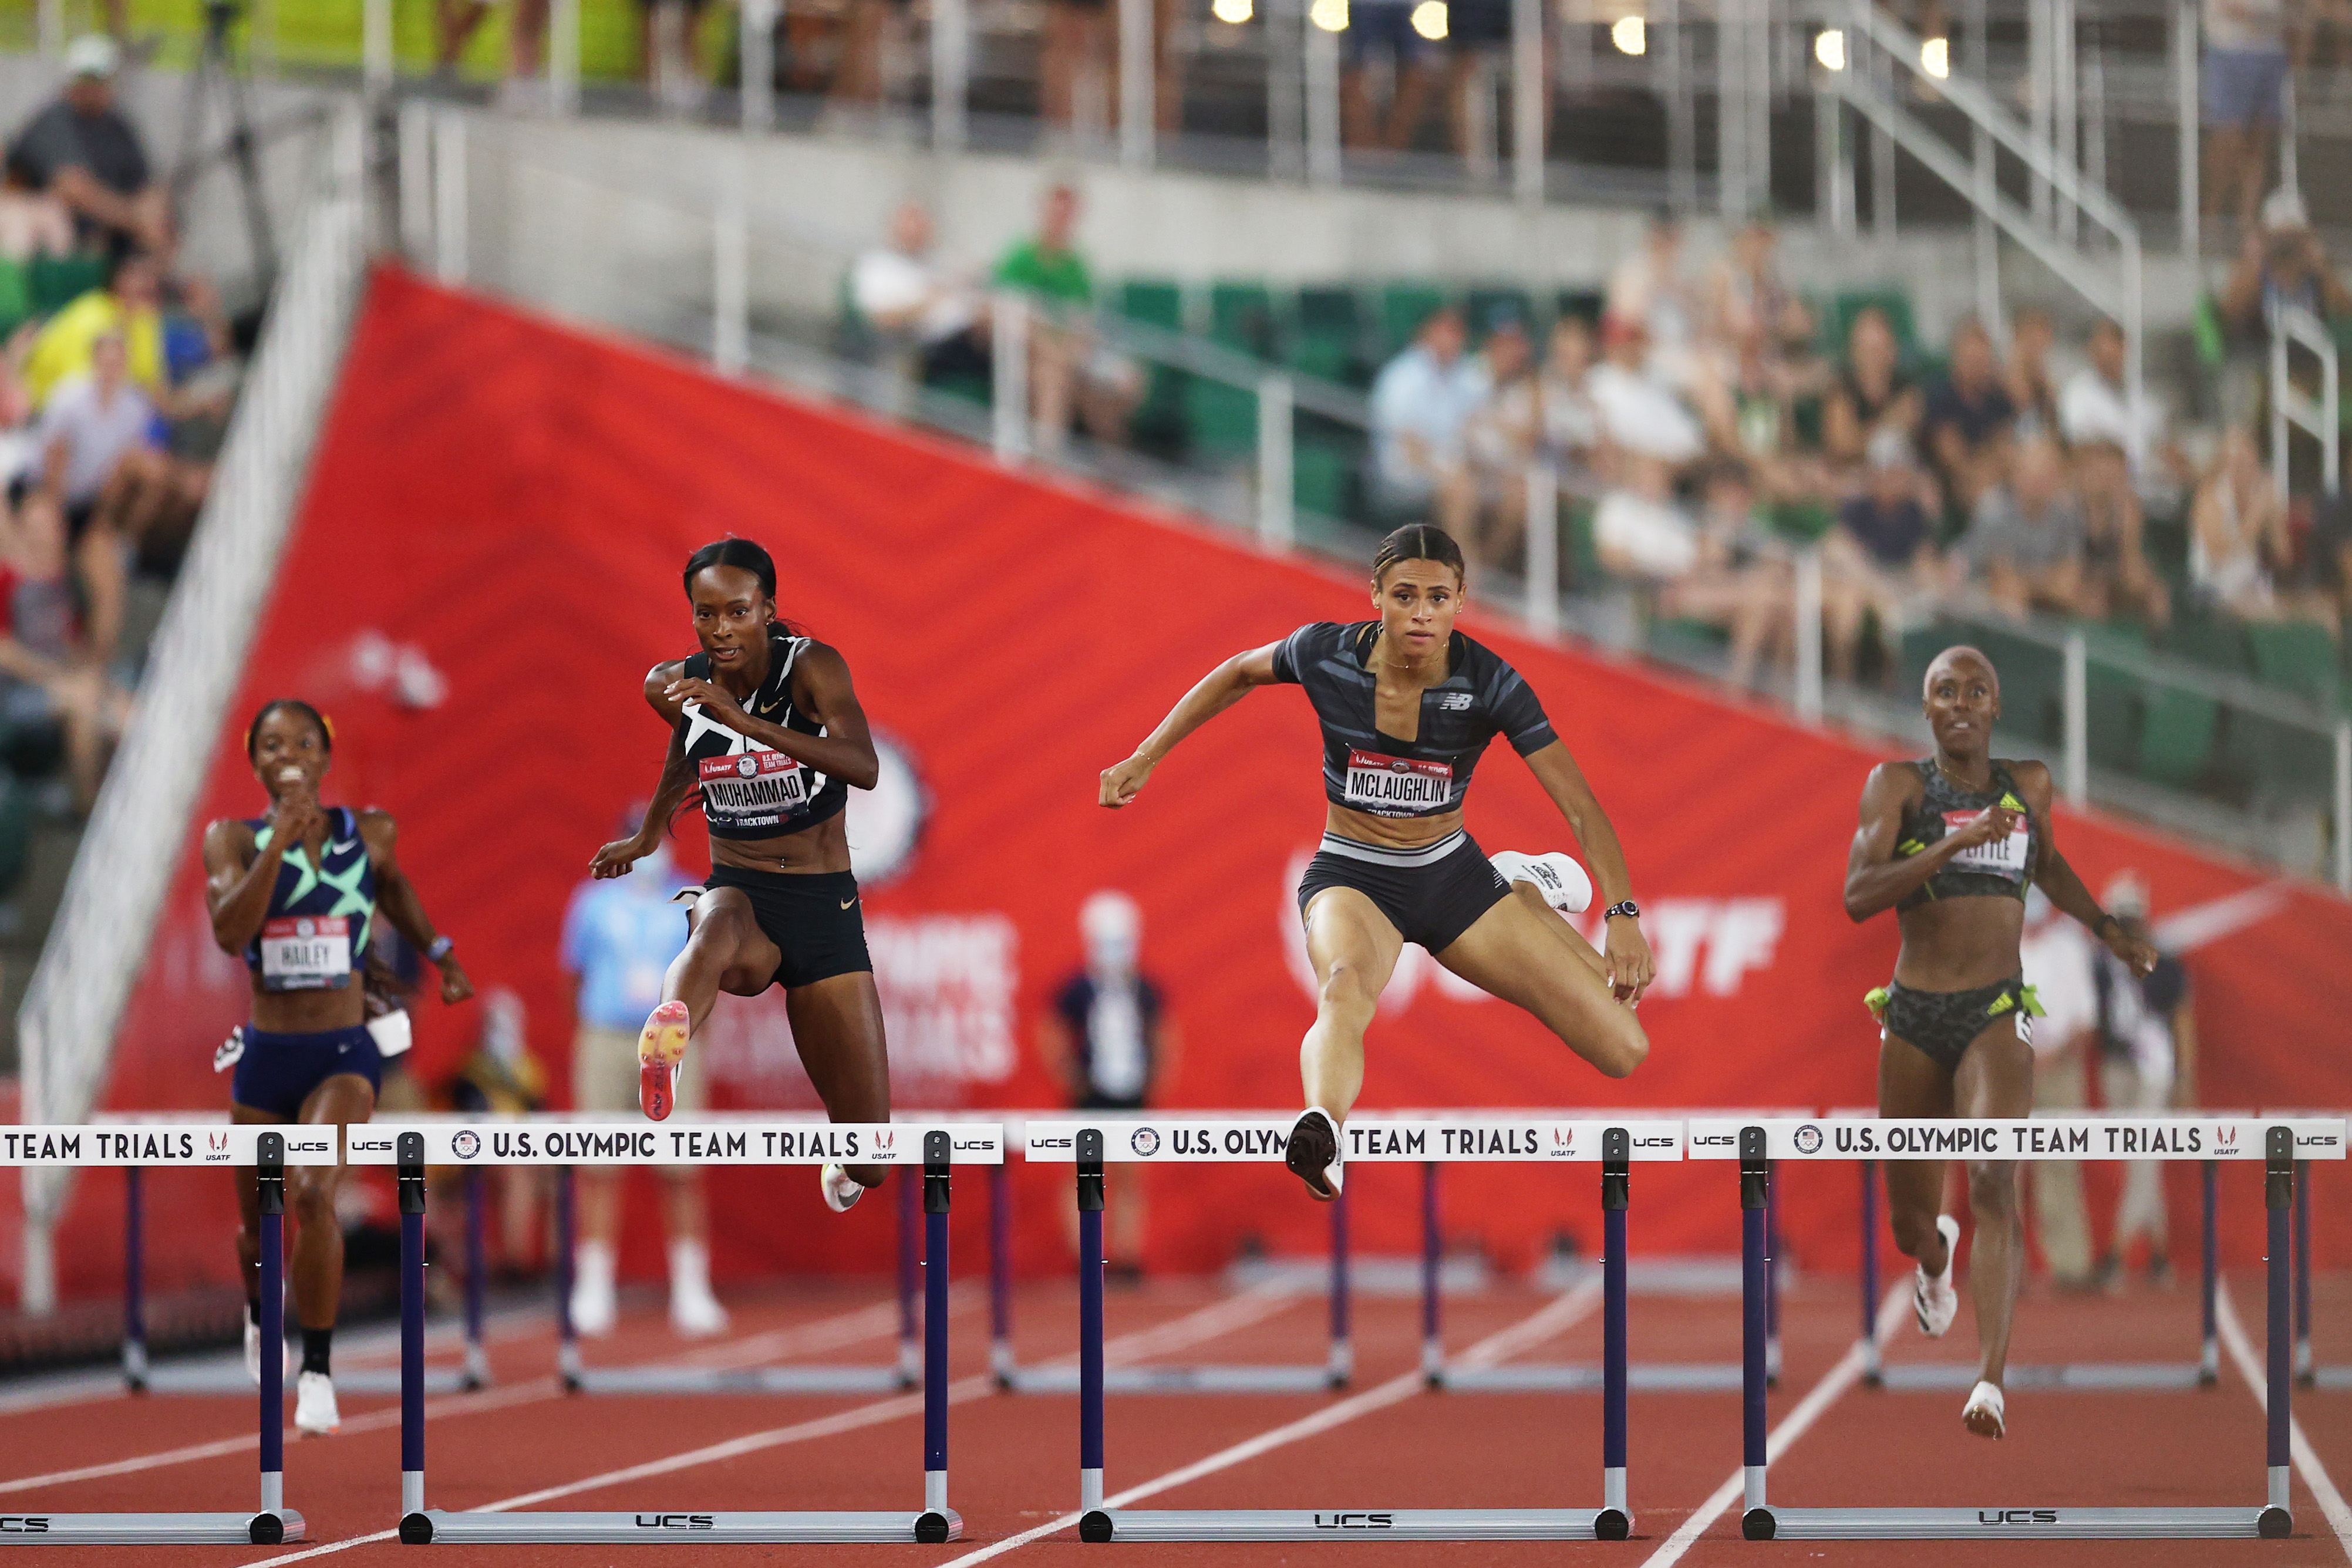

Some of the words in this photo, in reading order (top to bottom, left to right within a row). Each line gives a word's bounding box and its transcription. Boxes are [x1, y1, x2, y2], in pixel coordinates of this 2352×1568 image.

[712, 764, 732, 772] USATF
[710, 775, 801, 807] MUHAMMAD
[1351, 772, 1445, 802] MCLAUGHLIN
[735, 815, 780, 827] TRACKTOWN
[5, 1134, 80, 1158] TEAM
[96, 1134, 193, 1158] TRIALS
[288, 1142, 328, 1151] UCS
[352, 1142, 392, 1150] UCS
[494, 1132, 538, 1157] U.S.
[545, 1132, 655, 1157] OLYMPIC
[670, 1132, 746, 1157] TEAM
[762, 1132, 859, 1157] TRIALS
[954, 1141, 995, 1149] UCS
[1031, 1139, 1071, 1148] UCS
[1173, 1129, 1217, 1154] U.S.
[1224, 1129, 1290, 1154] OLYM
[1350, 1129, 1425, 1154] TEAM
[1441, 1129, 1538, 1154] TRIALS
[1633, 1138, 1673, 1147] UCS
[1694, 1136, 1734, 1145] UCS
[1835, 1128, 1880, 1152] U.S.
[1888, 1128, 1998, 1152] OLYMPIC
[2013, 1128, 2088, 1152] TEAM
[2104, 1128, 2201, 1152] TRIALS
[2297, 1137, 2337, 1145] UCS
[636, 1515, 713, 1529] UCS
[1315, 1514, 1392, 1528] UCS
[1979, 1510, 2057, 1525] UCS
[0, 1518, 49, 1532] CS
